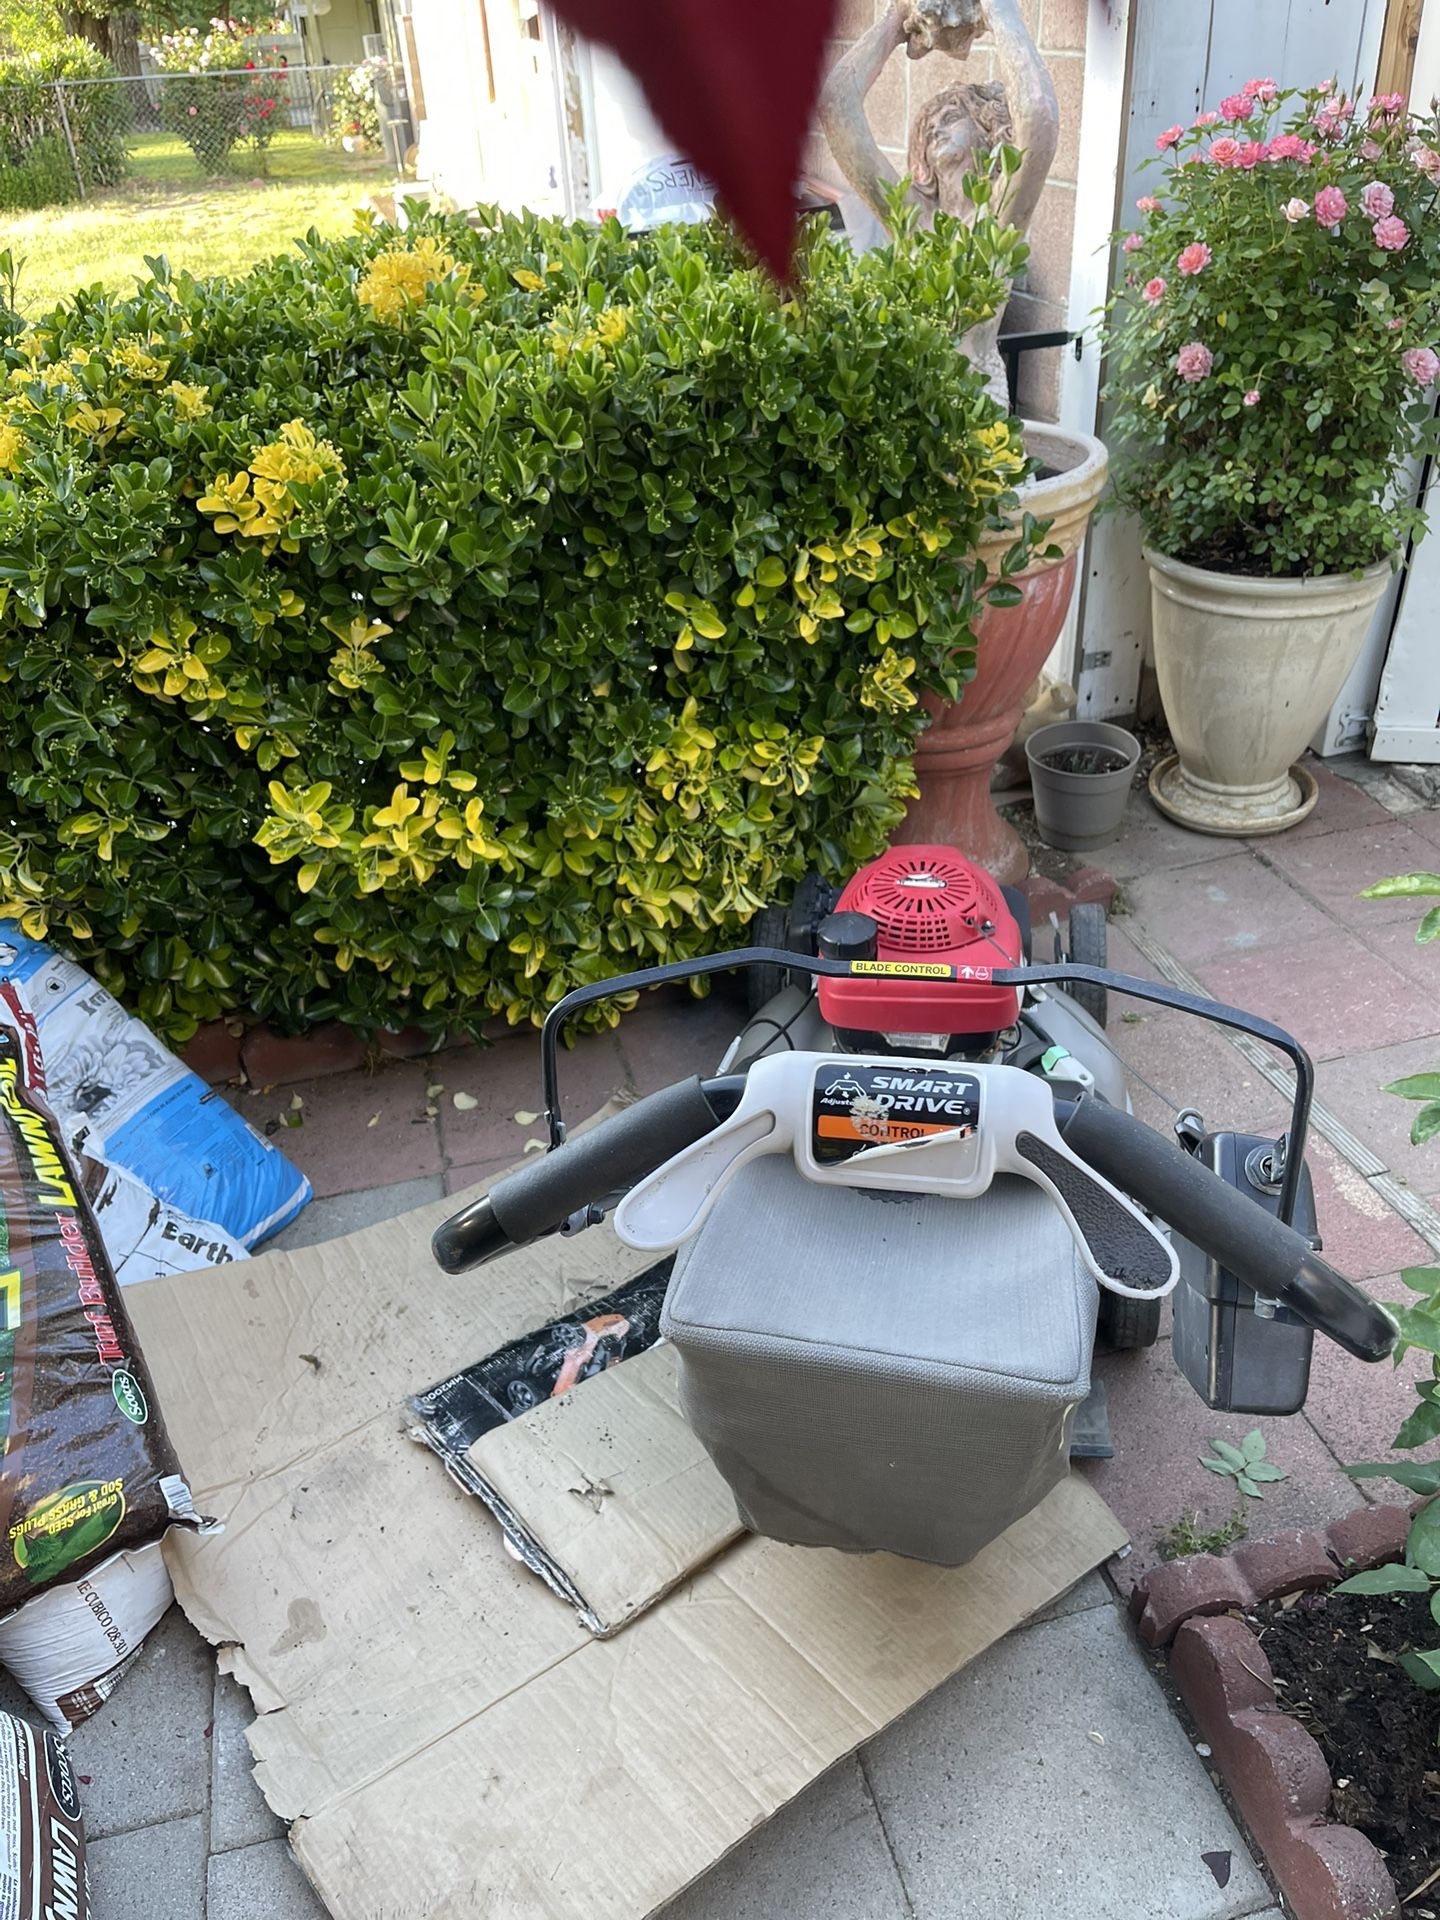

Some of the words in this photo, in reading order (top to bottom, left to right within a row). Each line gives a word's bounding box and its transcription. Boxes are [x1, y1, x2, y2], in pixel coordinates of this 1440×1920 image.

[855, 962, 892, 973] BLADE
[894, 964, 947, 976] CONTROL
[870, 1075, 974, 1096] SMART
[161, 1221, 234, 1265] Earth
[55, 1210, 106, 1306] Builder
[83, 1311, 125, 1366] Turf
[118, 1375, 144, 1416] Scotts
[88, 1488, 99, 1504] &
[100, 1477, 124, 1498] SOD
[48, 1494, 86, 1520] GRASS
[74, 1505, 92, 1519] For
[92, 1493, 118, 1513] Great
[8, 1512, 48, 1539] PLUGS
[85, 1592, 114, 1630] CUBICO
[103, 1624, 129, 1658] (28.3L)
[53, 1735, 75, 1808] Scotts
